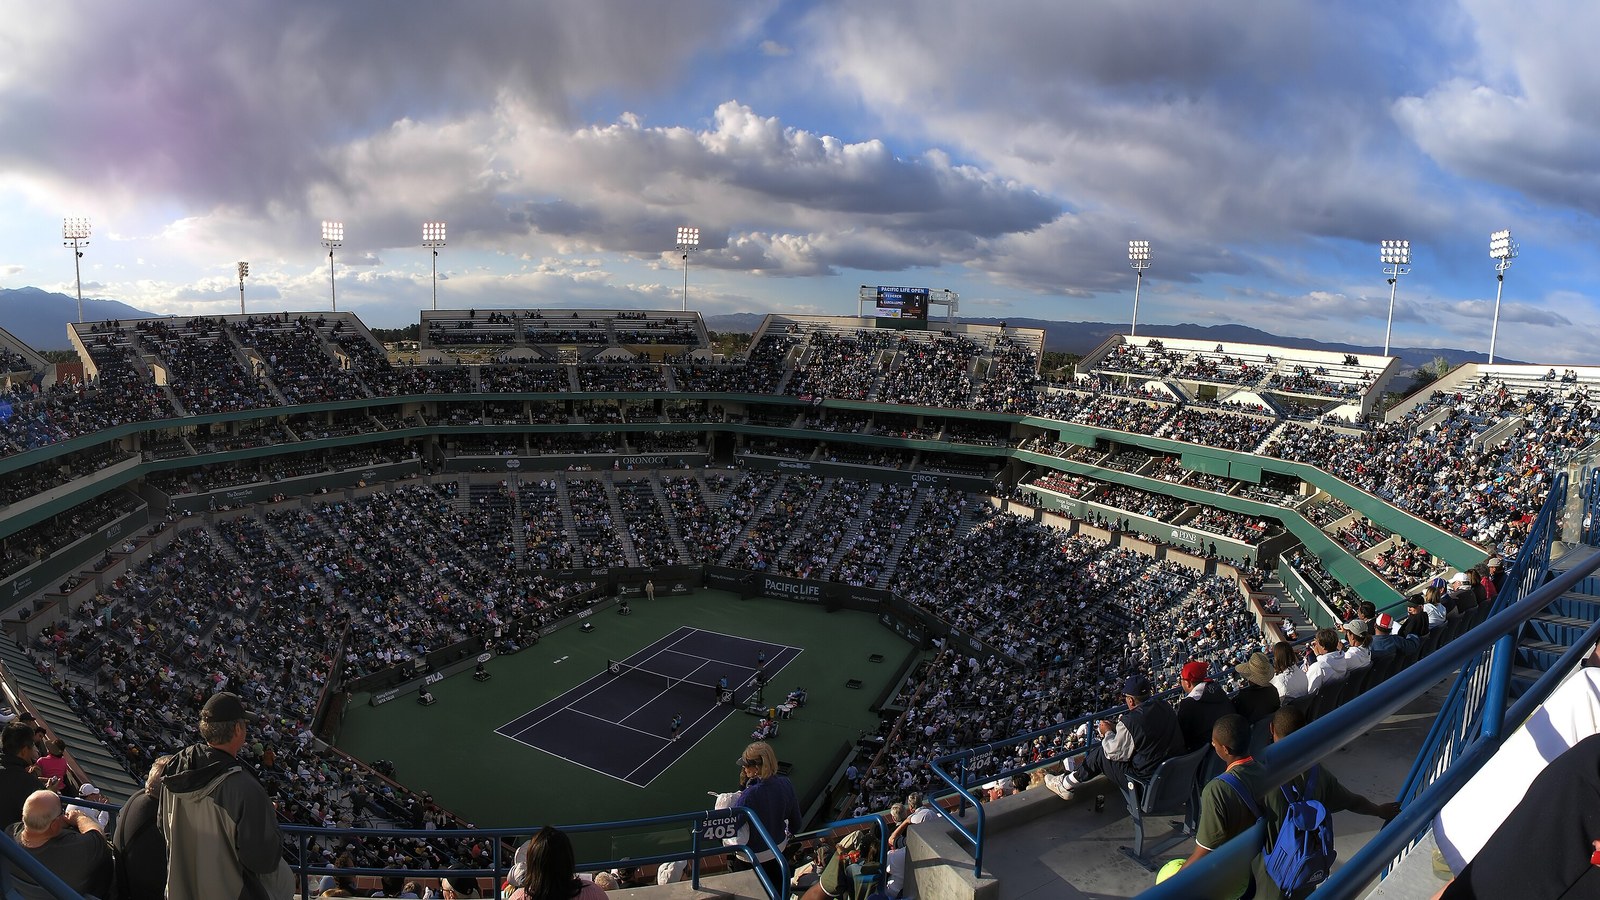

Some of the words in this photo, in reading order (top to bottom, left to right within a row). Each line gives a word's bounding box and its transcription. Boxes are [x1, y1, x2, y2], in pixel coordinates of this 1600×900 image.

[764, 578, 799, 594] PACIFIC
[800, 584, 820, 596] LIFE
[424, 671, 444, 685] FILA
[968, 756, 991, 772] 404
[970, 750, 993, 763] SECTION
[702, 816, 737, 827] SECTION
[703, 824, 736, 840] 405
